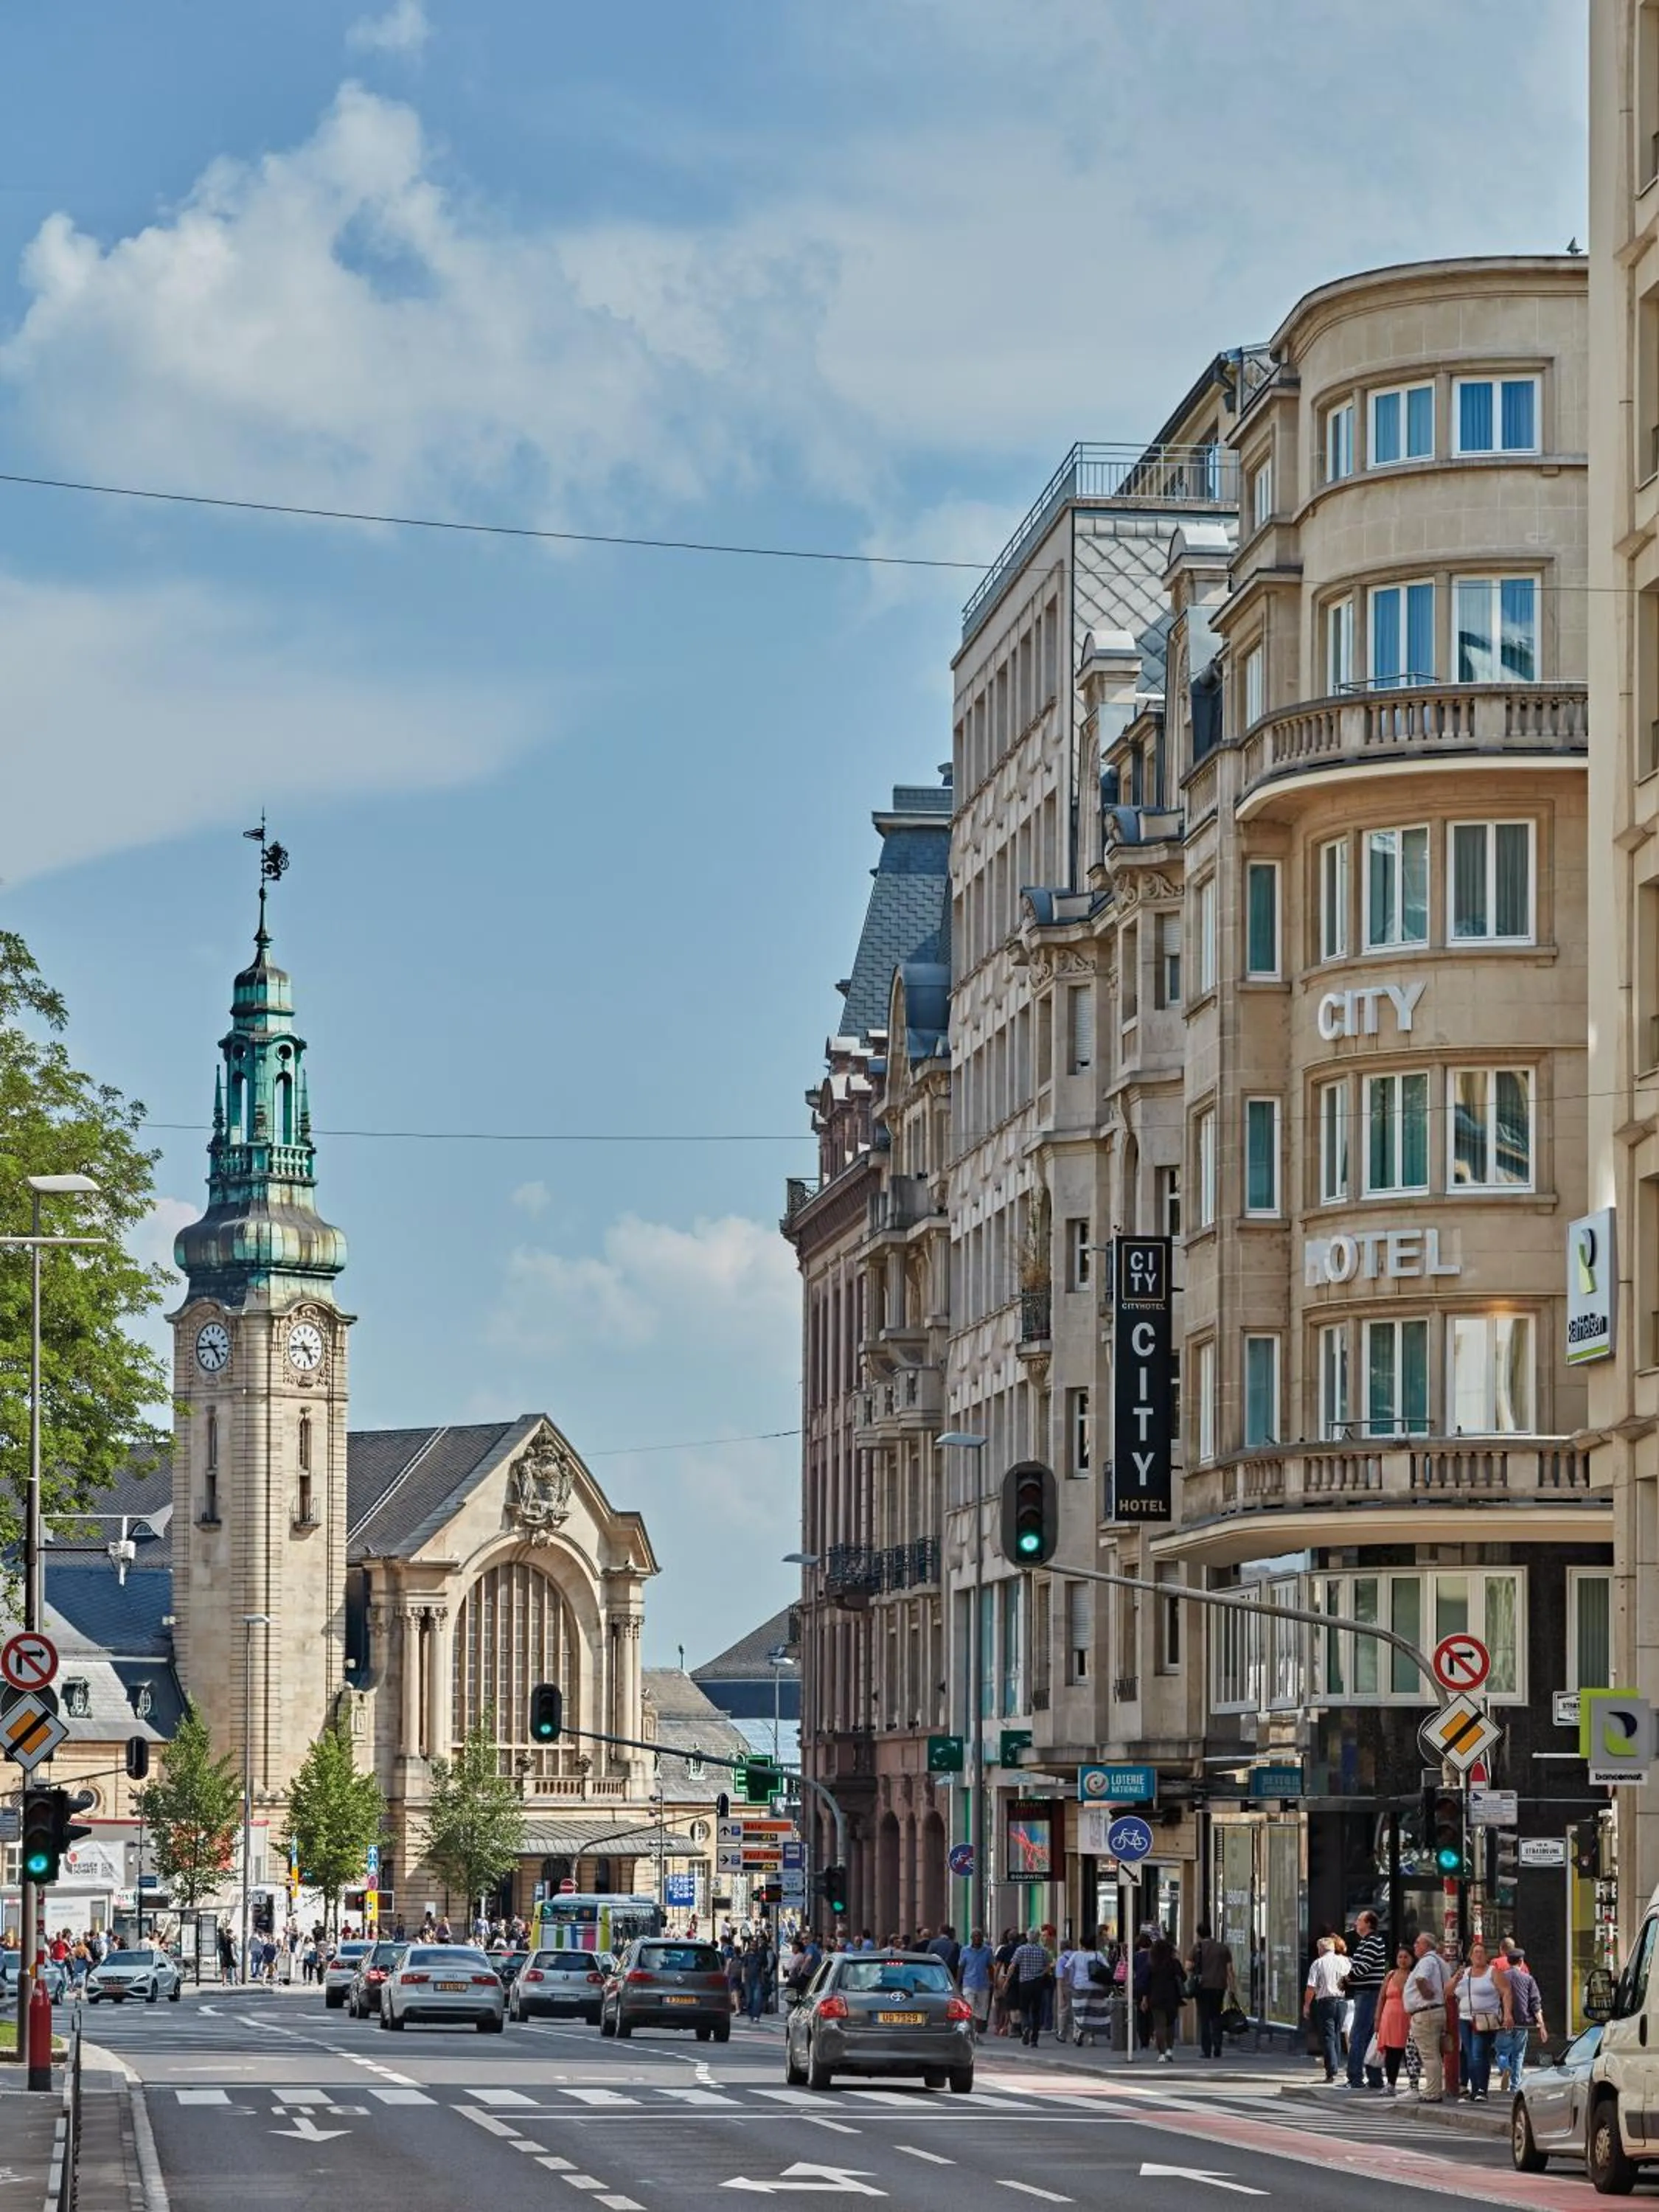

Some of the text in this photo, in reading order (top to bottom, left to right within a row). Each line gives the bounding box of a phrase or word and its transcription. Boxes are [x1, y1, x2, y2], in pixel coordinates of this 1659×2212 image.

[1318, 981, 1427, 1040] CITY
[1304, 1228, 1461, 1287] HOTEL
[1131, 1322, 1155, 1486] CITY
[1119, 1500, 1166, 1512] HOTEL
[1111, 1774, 1144, 1785] LOTERIE
[1111, 1786, 1144, 1794] NATIONALE
